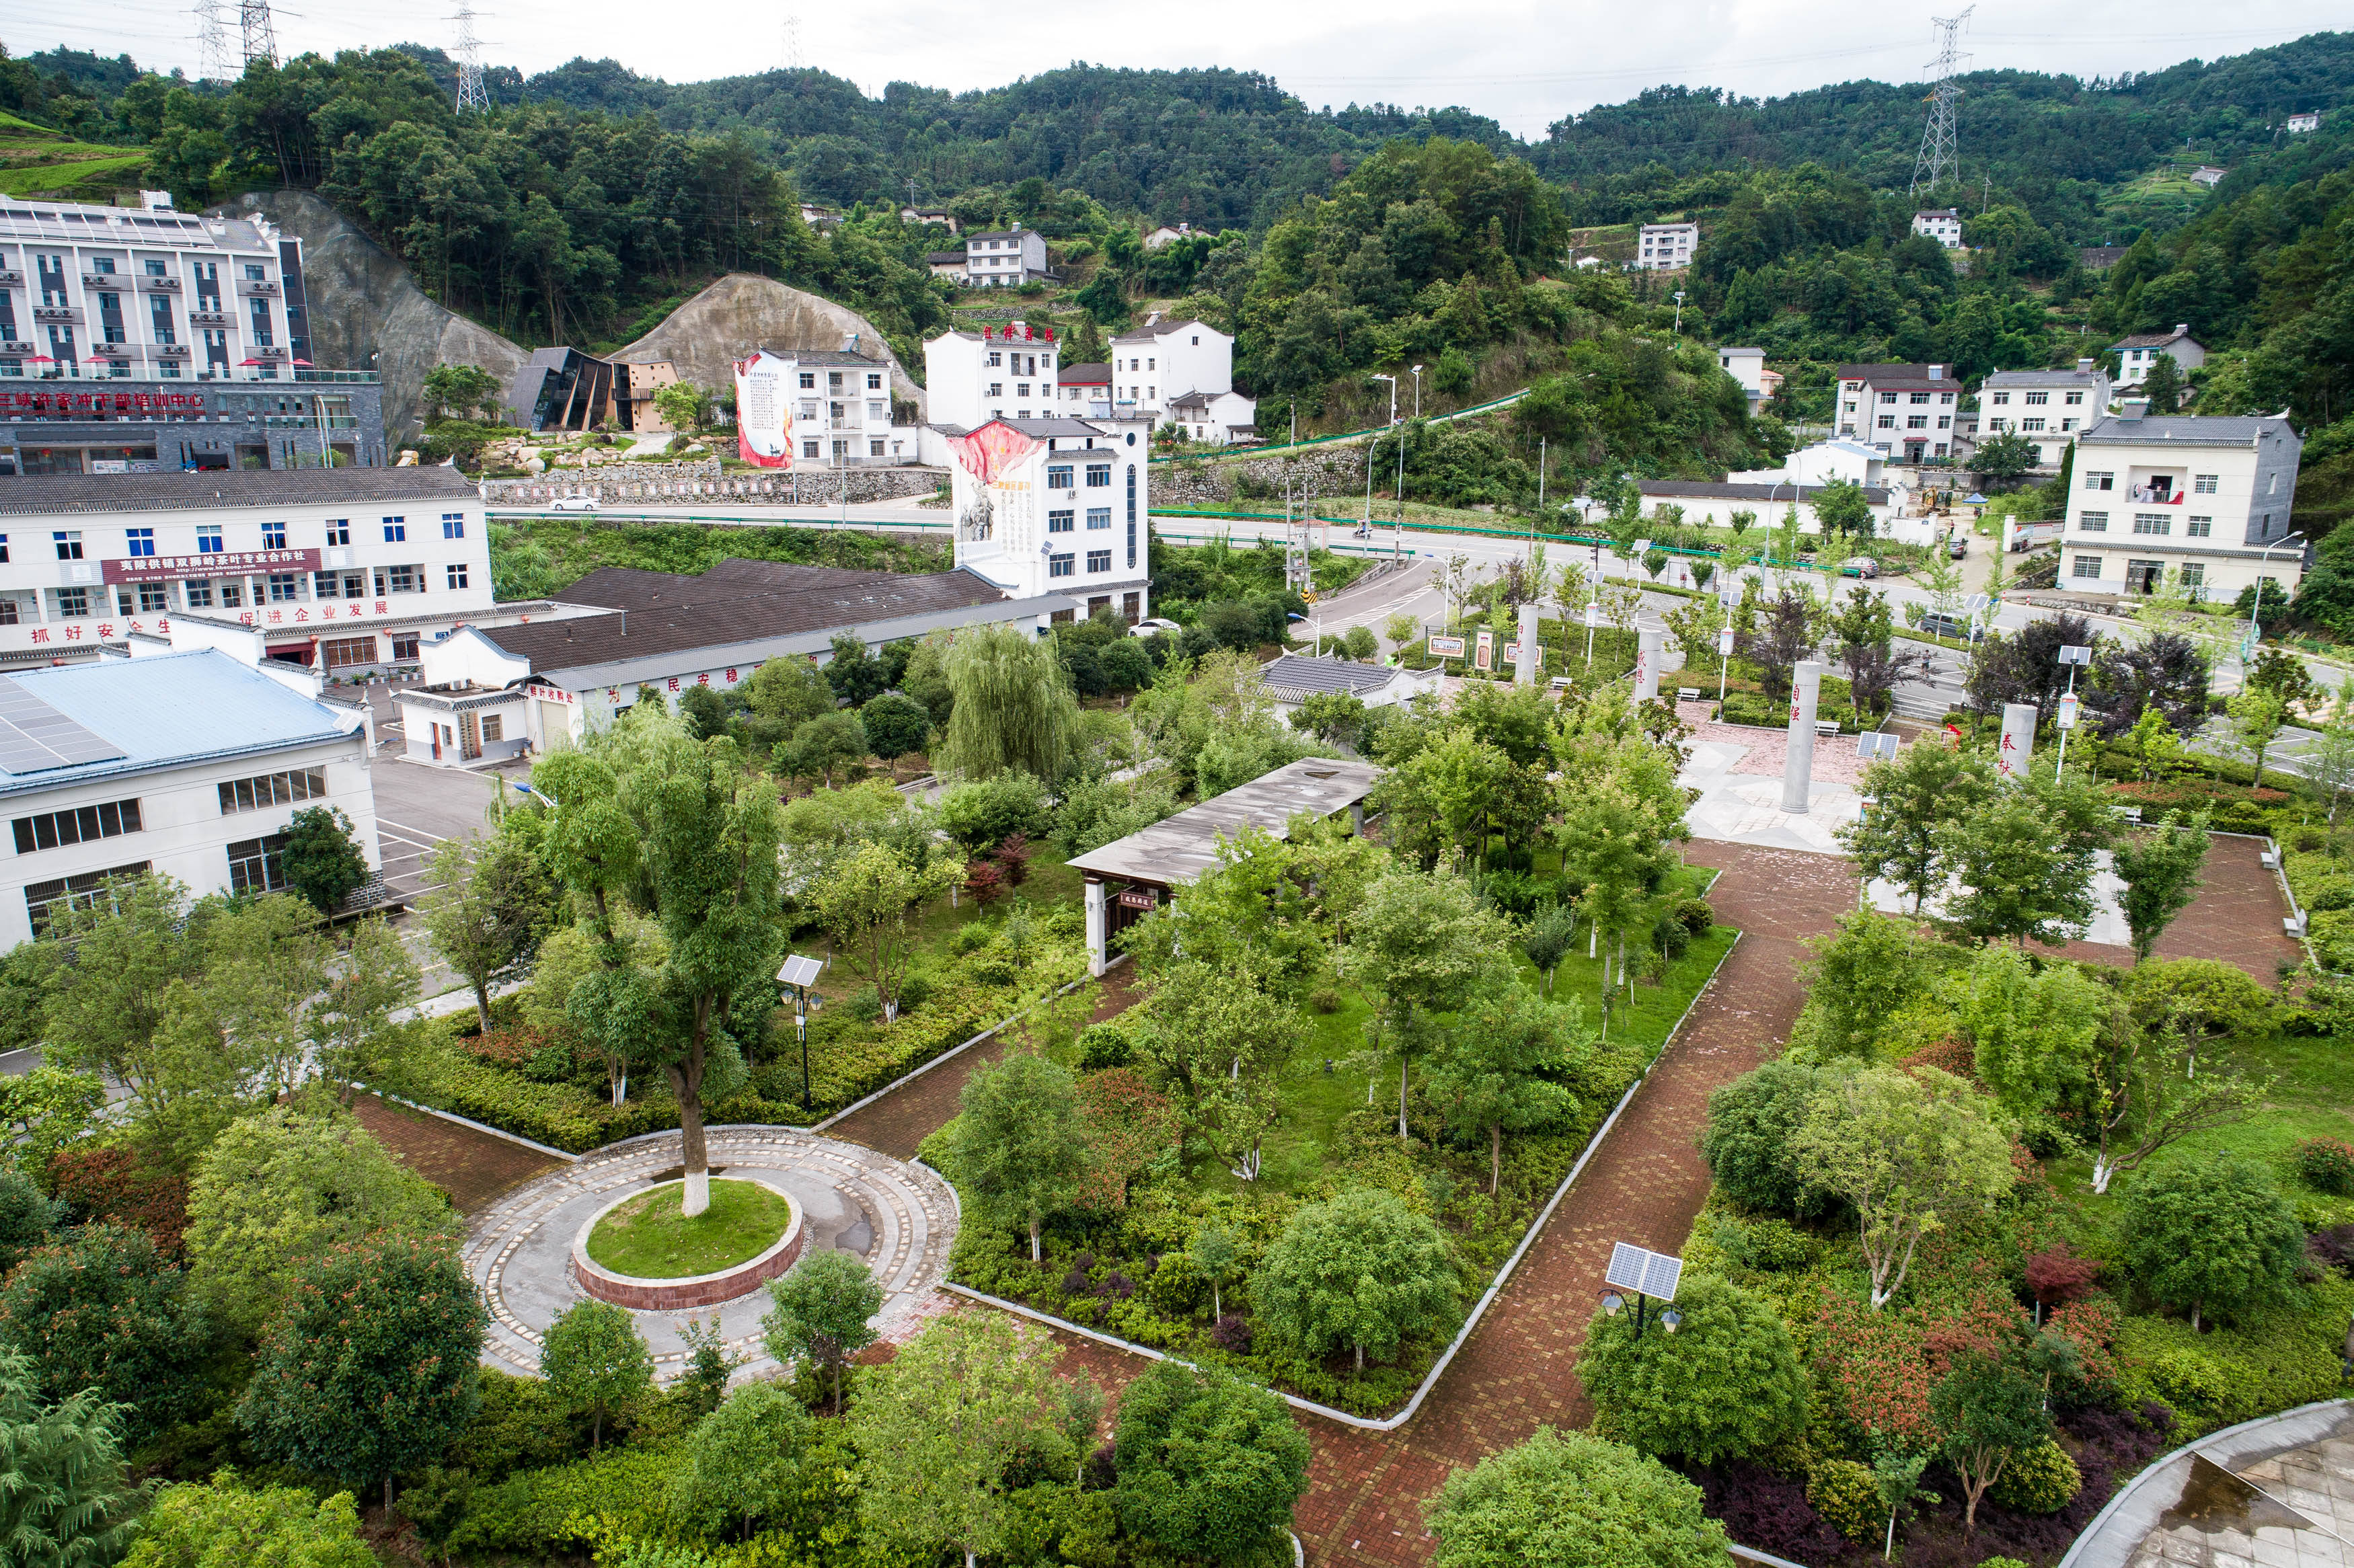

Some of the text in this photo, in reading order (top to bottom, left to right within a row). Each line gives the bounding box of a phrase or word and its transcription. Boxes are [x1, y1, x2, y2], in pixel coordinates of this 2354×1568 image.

[0, 393, 204, 407] 三峡许家冲干部培训中心
[120, 551, 306, 572] 夷陵供销双狮岭茶叶专业合作社
[1636, 650, 1646, 684] 感恩
[530, 685, 573, 703] 鲜叶收购处
[1790, 684, 1800, 721] 自强
